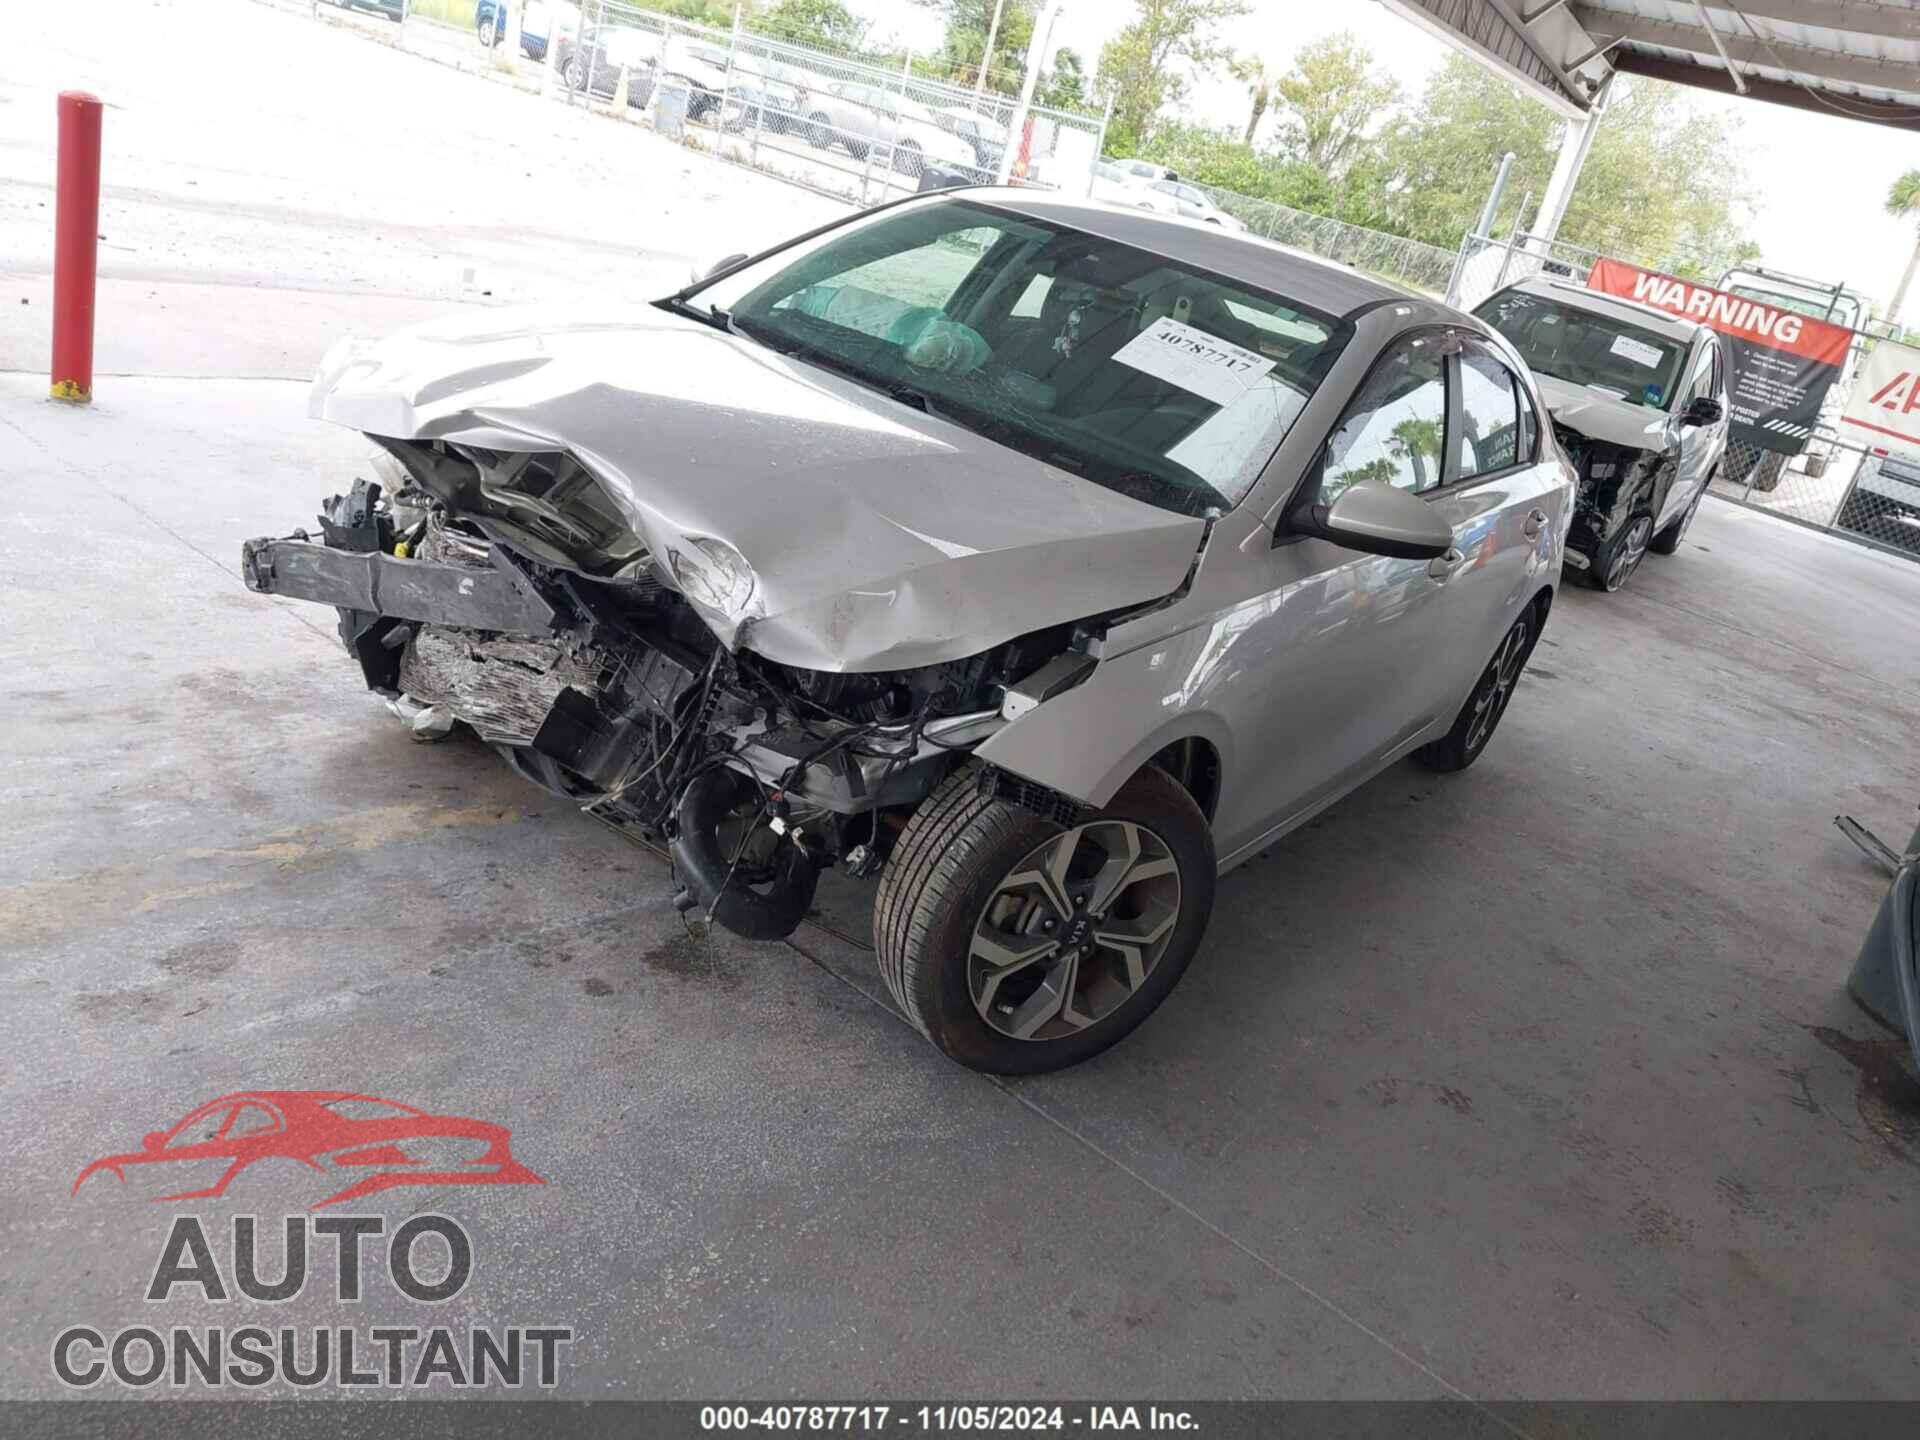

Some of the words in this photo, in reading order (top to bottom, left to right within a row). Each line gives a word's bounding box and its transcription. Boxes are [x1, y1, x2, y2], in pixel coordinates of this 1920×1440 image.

[1632, 273, 1804, 344] WARNING
[1157, 331, 1252, 373] 40787717
[1068, 919, 1087, 945] KIA
